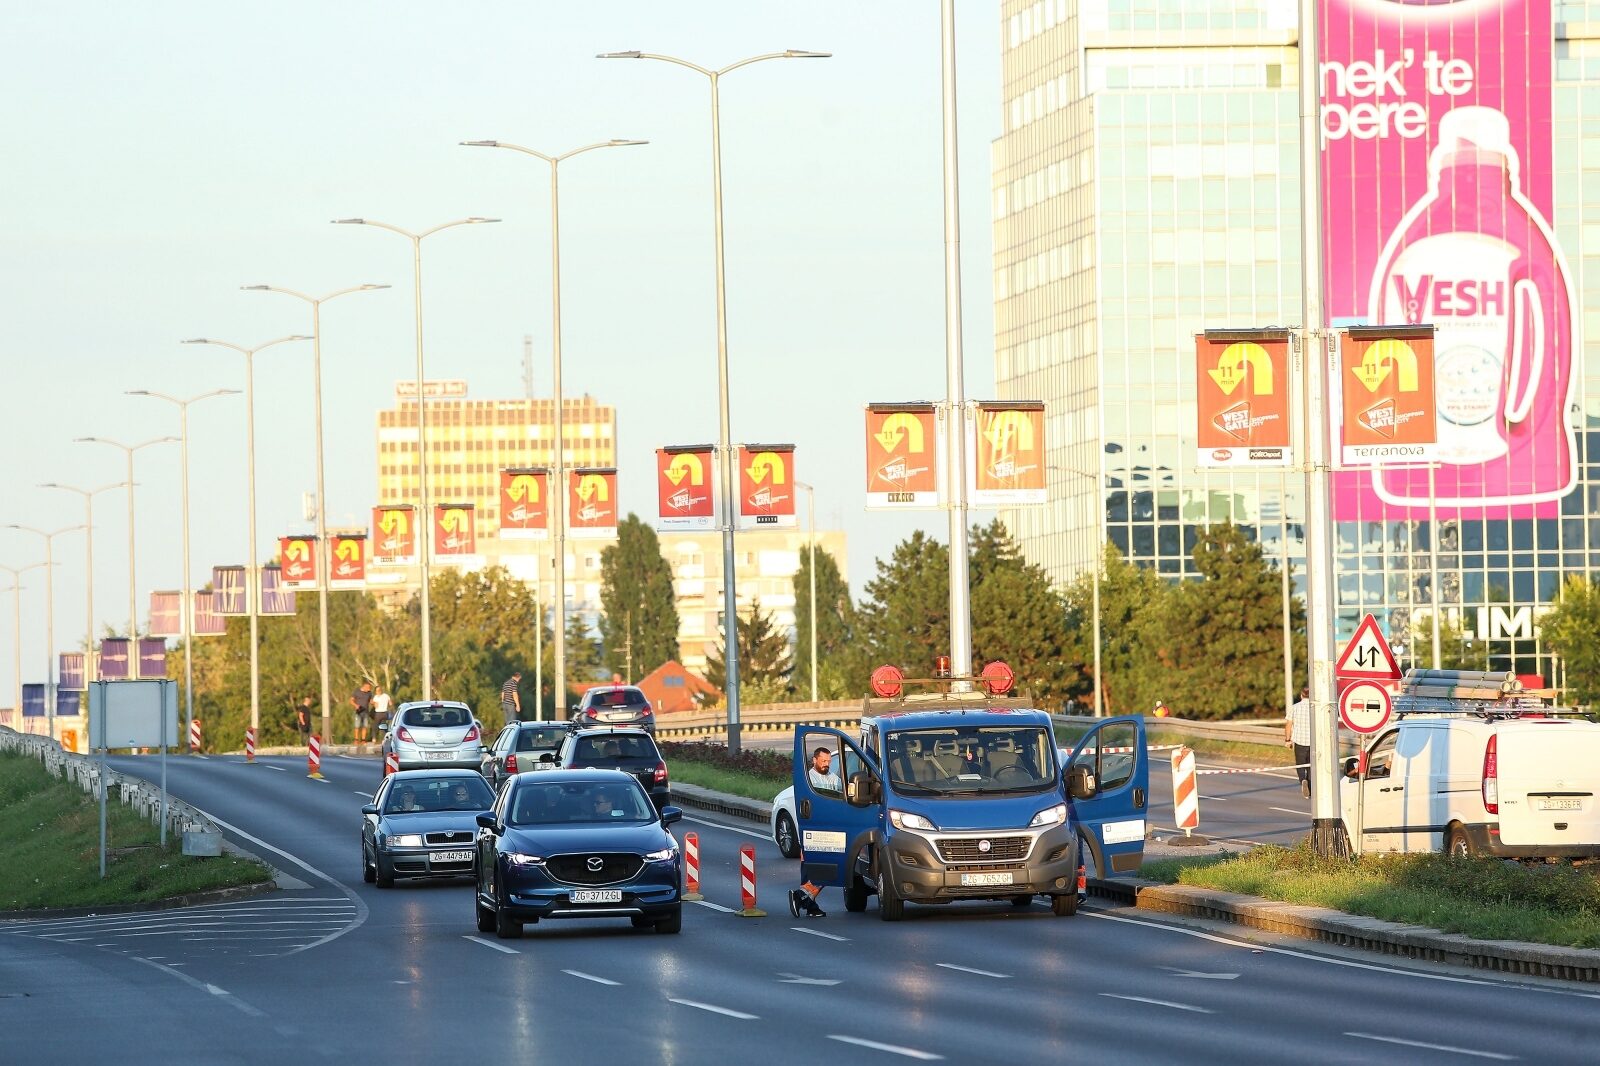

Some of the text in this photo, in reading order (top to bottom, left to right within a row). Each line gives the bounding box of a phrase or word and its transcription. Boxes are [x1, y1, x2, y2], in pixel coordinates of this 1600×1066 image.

[1320, 49, 1474, 98] nek' te
[1320, 101, 1426, 152] pere
[1392, 274, 1505, 325] VESH
[1220, 366, 1232, 378] 11
[1365, 364, 1377, 375] 11
[1221, 409, 1249, 423] WEST
[1367, 406, 1394, 420] WEST
[1370, 416, 1394, 428] GATE
[884, 431, 893, 440] 11
[434, 853, 443, 861] ZG
[967, 875, 977, 884] ZG
[575, 891, 586, 901] ZG
